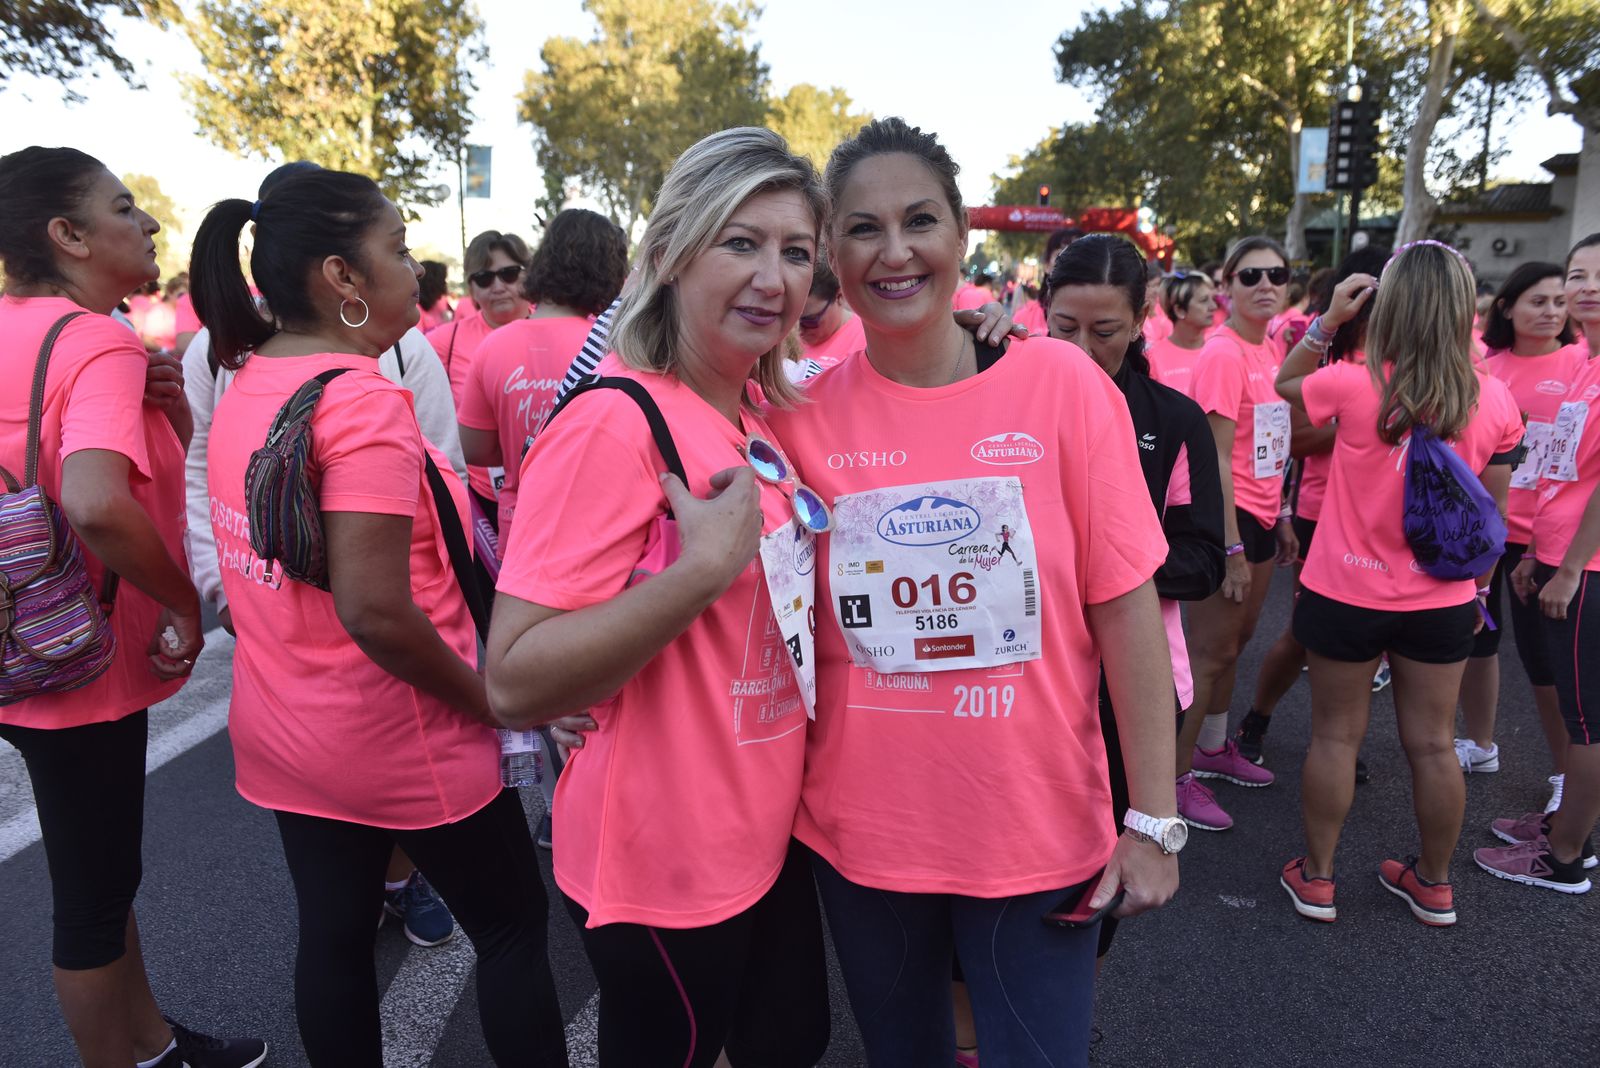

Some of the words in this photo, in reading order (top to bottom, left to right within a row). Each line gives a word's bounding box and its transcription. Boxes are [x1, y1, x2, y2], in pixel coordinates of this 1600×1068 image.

[827, 450, 907, 470] OYSHO
[977, 445, 1039, 458] ASTURIANA
[885, 516, 973, 537] ASTURIANA
[948, 543, 989, 555] Carrera
[974, 552, 1002, 571] Mujer
[1343, 553, 1389, 573] OYSHO
[891, 571, 977, 609] 016
[915, 613, 958, 631] 5186
[931, 643, 967, 652] Santander
[995, 643, 1027, 655] ZURICH
[876, 674, 883, 688] A
[886, 672, 930, 690] CORUÑA
[953, 685, 1015, 718] 2019
